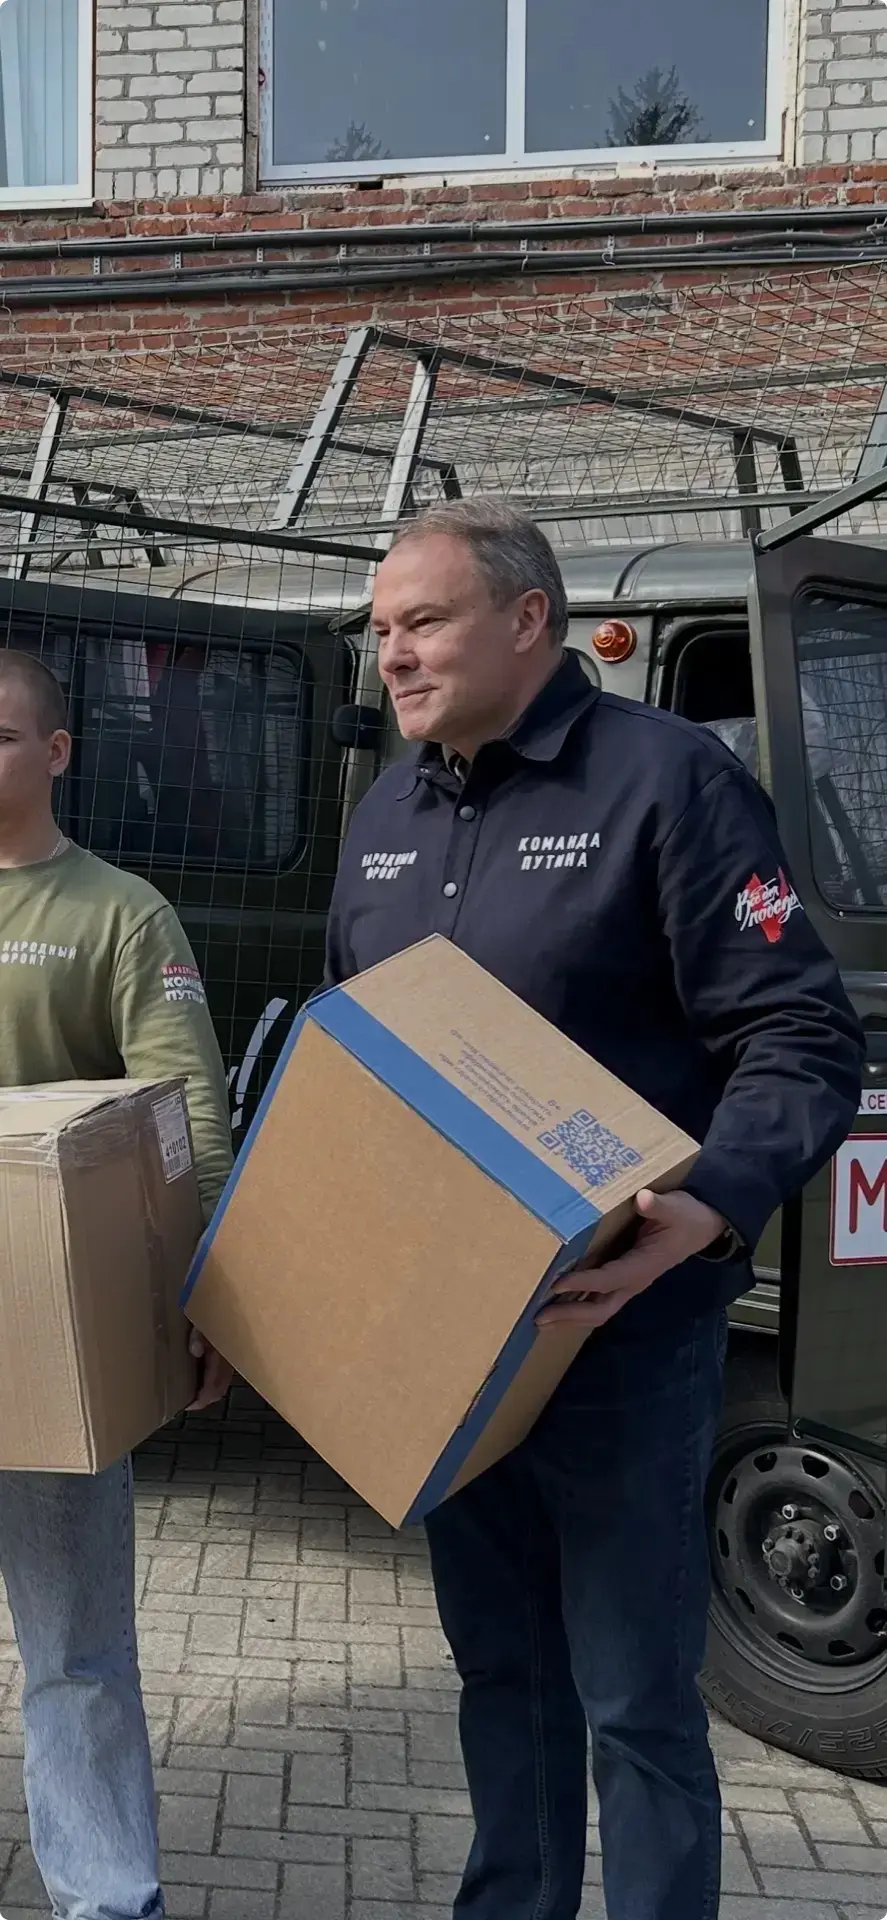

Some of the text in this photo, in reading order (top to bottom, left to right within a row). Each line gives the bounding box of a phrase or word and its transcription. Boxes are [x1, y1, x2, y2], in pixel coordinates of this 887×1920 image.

[518, 832, 600, 852] КОМАНДА
[520, 852, 588, 871] ПУТИНА
[0, 952, 47, 966] ФРОНТ
[2, 940, 78, 960] НАРОДНЫЙ
